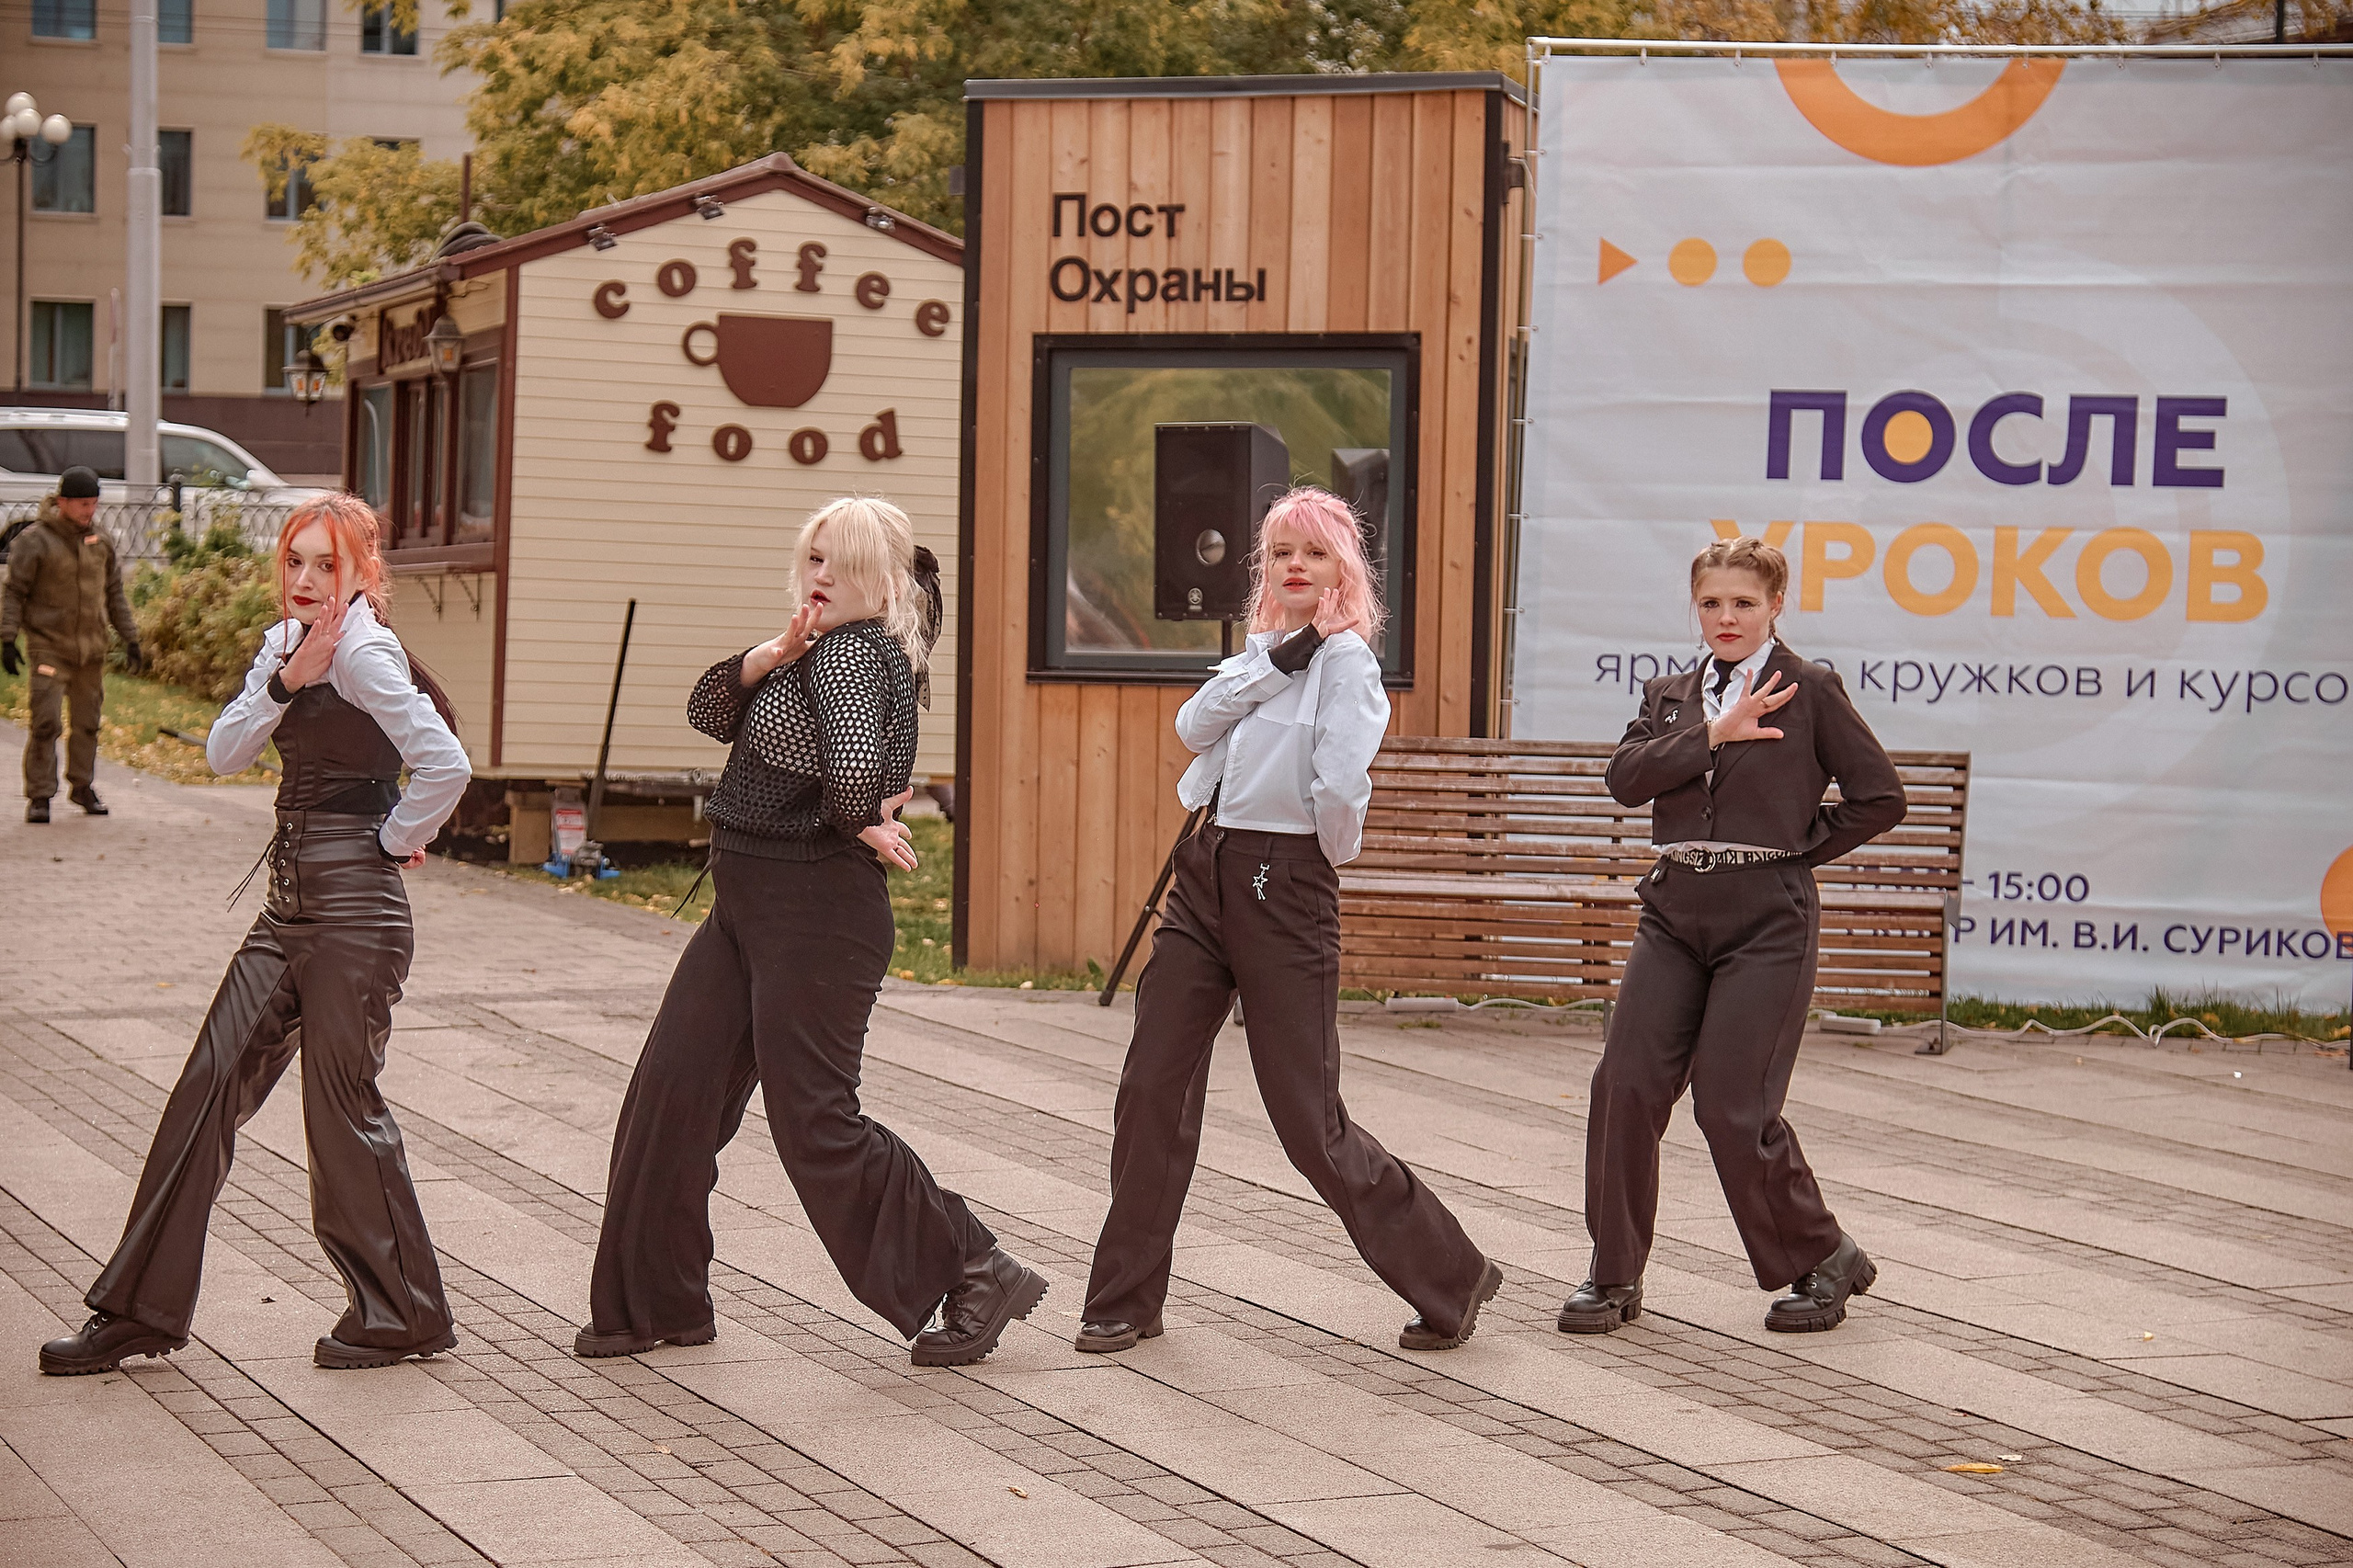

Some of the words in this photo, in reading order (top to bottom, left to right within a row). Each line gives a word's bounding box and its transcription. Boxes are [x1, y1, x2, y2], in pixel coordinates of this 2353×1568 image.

[1052, 192, 1186, 238] Пост
[594, 236, 951, 337] coffee
[1050, 256, 1267, 313] Охраны
[644, 400, 904, 464] food
[1765, 389, 2228, 488] ПОСЛЕ
[1859, 658, 2104, 704] кружков
[2126, 667, 2157, 699] и
[2178, 669, 2350, 712] курсо
[1988, 870, 2090, 903] 15:00
[1990, 916, 2059, 949] ИМ.
[2074, 920, 2150, 952] В.И.
